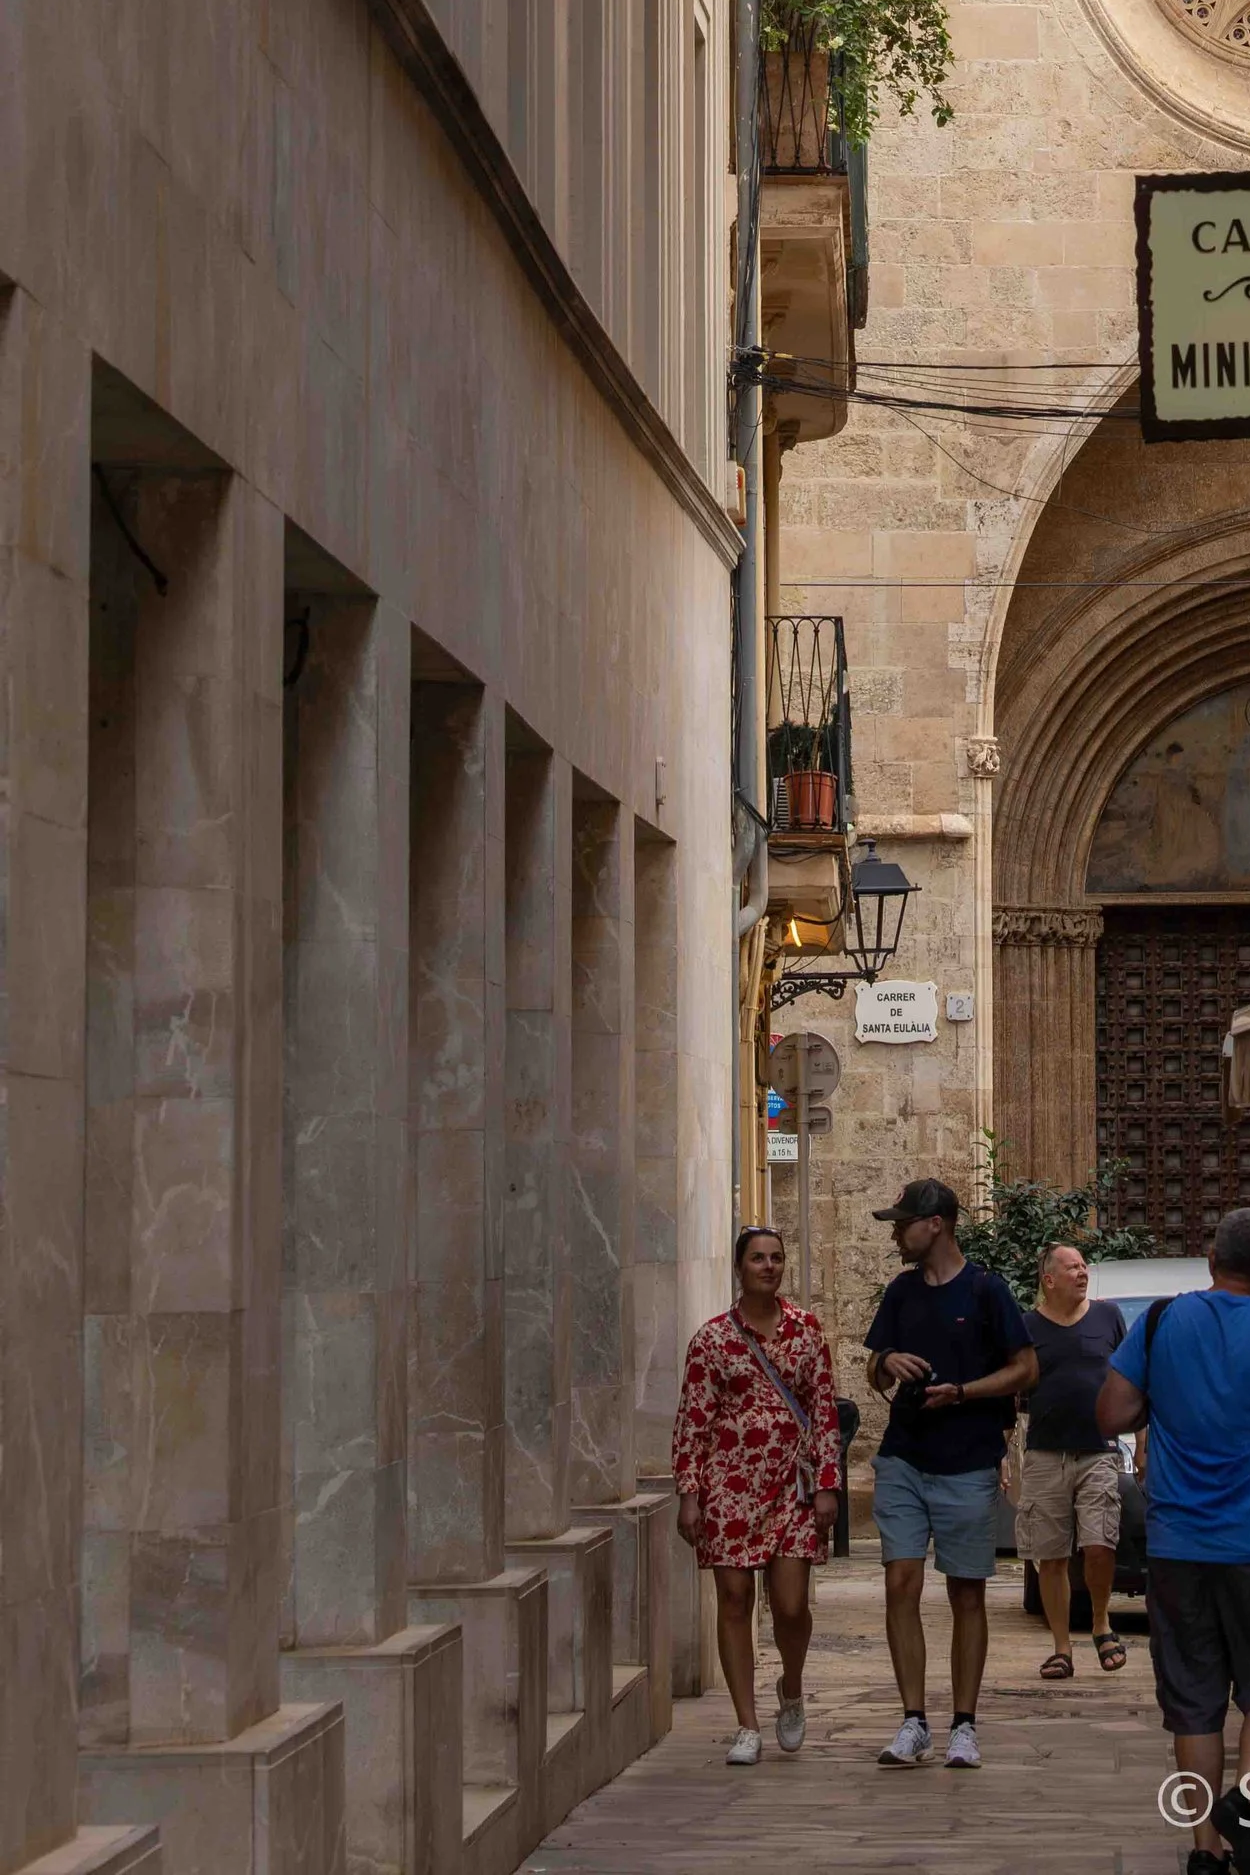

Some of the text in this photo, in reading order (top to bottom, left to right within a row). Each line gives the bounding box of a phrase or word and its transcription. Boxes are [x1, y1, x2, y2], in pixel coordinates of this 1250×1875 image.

[876, 992, 916, 1002] CARRER
[955, 999, 965, 1014] 2
[890, 1008, 903, 1017] DE
[862, 1021, 931, 1033] SANTA EULÀLIA
